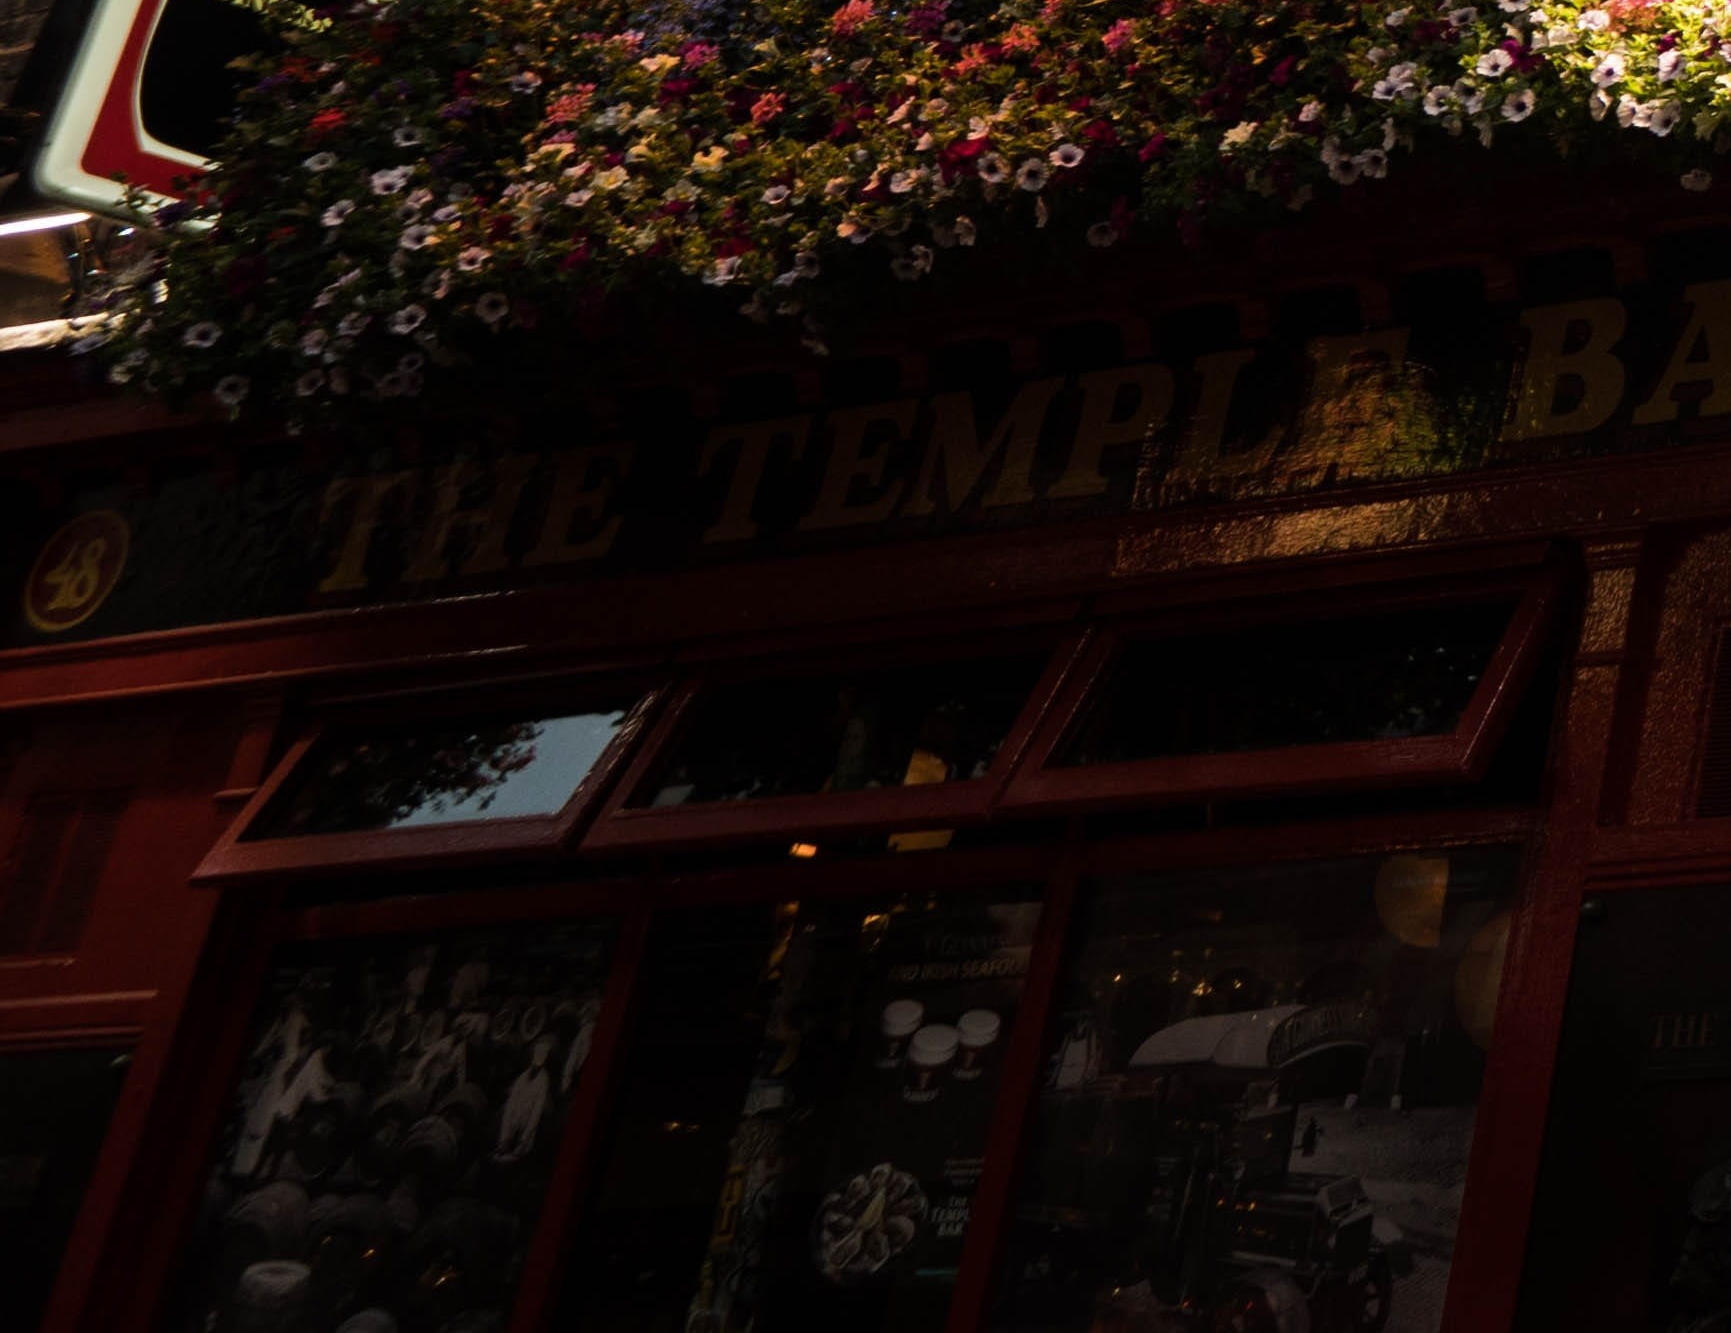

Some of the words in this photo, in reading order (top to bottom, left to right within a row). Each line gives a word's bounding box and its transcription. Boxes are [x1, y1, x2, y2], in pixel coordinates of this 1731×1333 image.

[318, 438, 638, 594] THE
[697, 326, 1412, 545] TEMPLE
[43, 535, 107, 612] 48
[1648, 1011, 1718, 1050] THE
